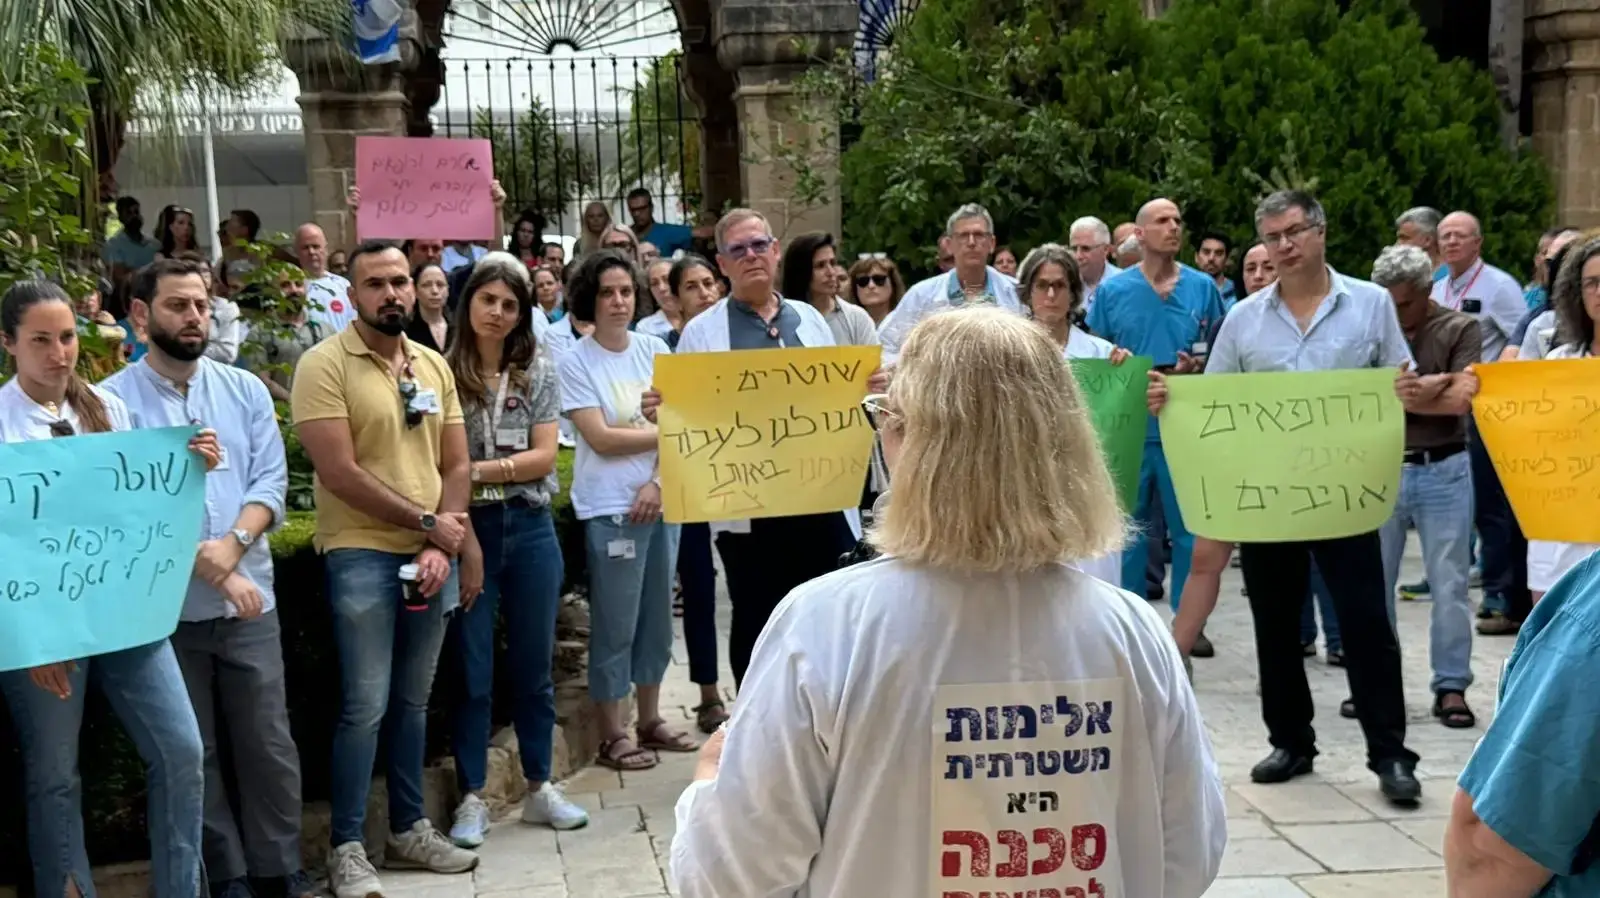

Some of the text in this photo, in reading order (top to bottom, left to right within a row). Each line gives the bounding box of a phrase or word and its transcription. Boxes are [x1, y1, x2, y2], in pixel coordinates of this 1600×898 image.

[737, 360, 861, 392] שוטרים
[663, 405, 862, 460] תנו לנו לעבוד
[1199, 392, 1383, 439] הרופאים
[94, 451, 189, 496] שוטר
[709, 459, 791, 494] באותו
[1235, 479, 1388, 516] אויבים
[39, 519, 174, 556] אני רופאה
[124, 556, 140, 580] לי
[148, 557, 175, 596] תן
[0, 579, 40, 601] בש
[945, 696, 1112, 742] אלימות
[944, 746, 1111, 779] משטרתית
[1007, 791, 1059, 813] היא
[941, 823, 1107, 877] סכנה
